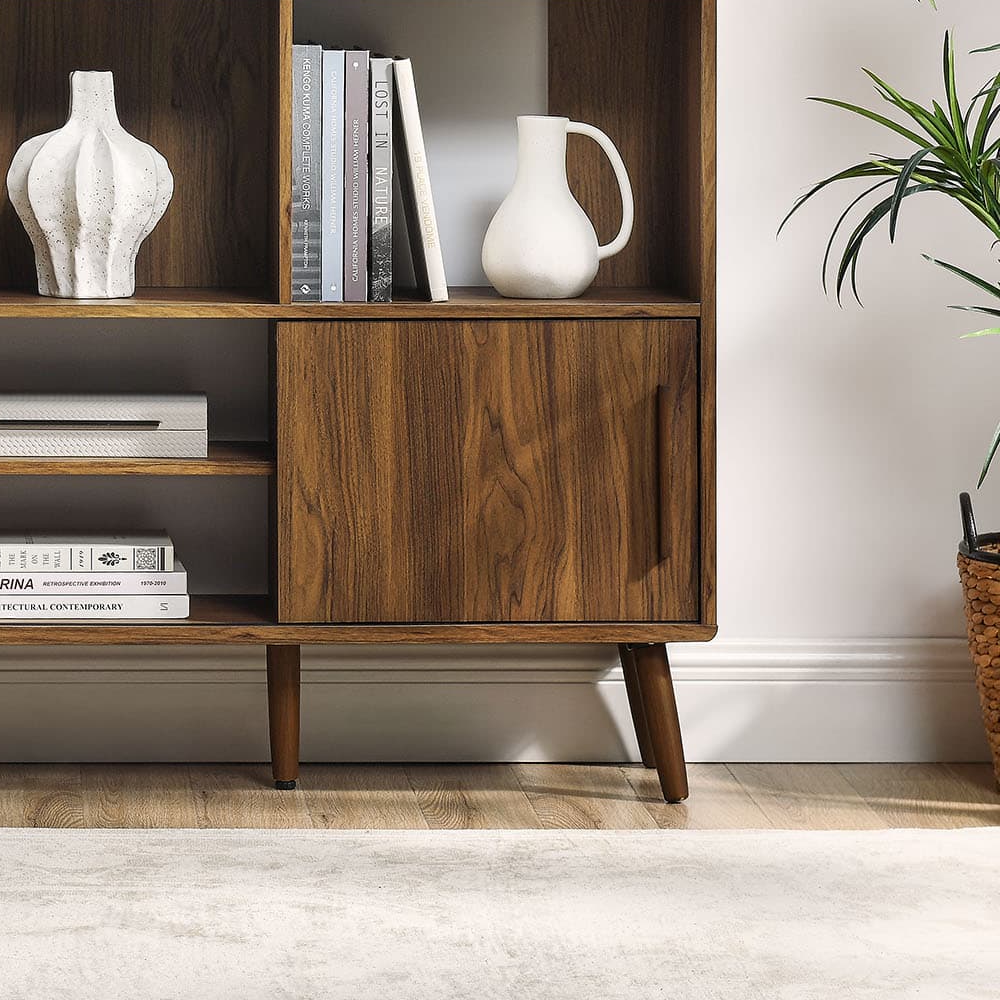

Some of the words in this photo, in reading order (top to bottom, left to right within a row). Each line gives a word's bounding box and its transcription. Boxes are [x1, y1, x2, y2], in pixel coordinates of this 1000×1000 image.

[302, 58, 311, 91] KENGO
[302, 93, 311, 121] KUMA
[330, 71, 338, 112] CALIFORNIA
[375, 81, 389, 119] LOST
[302, 122, 311, 173] COMPLETE
[375, 132, 389, 149] IN
[351, 149, 359, 180] WILLIAM
[302, 175, 311, 210] WORKS
[351, 181, 359, 209] STUDIO
[374, 167, 388, 225] NATURE
[351, 211, 359, 238] HOMES
[421, 199, 436, 249] VENDOME
[351, 240, 359, 282] CALIFORNIA
[31, 554, 38, 565] ON
[50, 603, 123, 611] CONTEMPORARY
